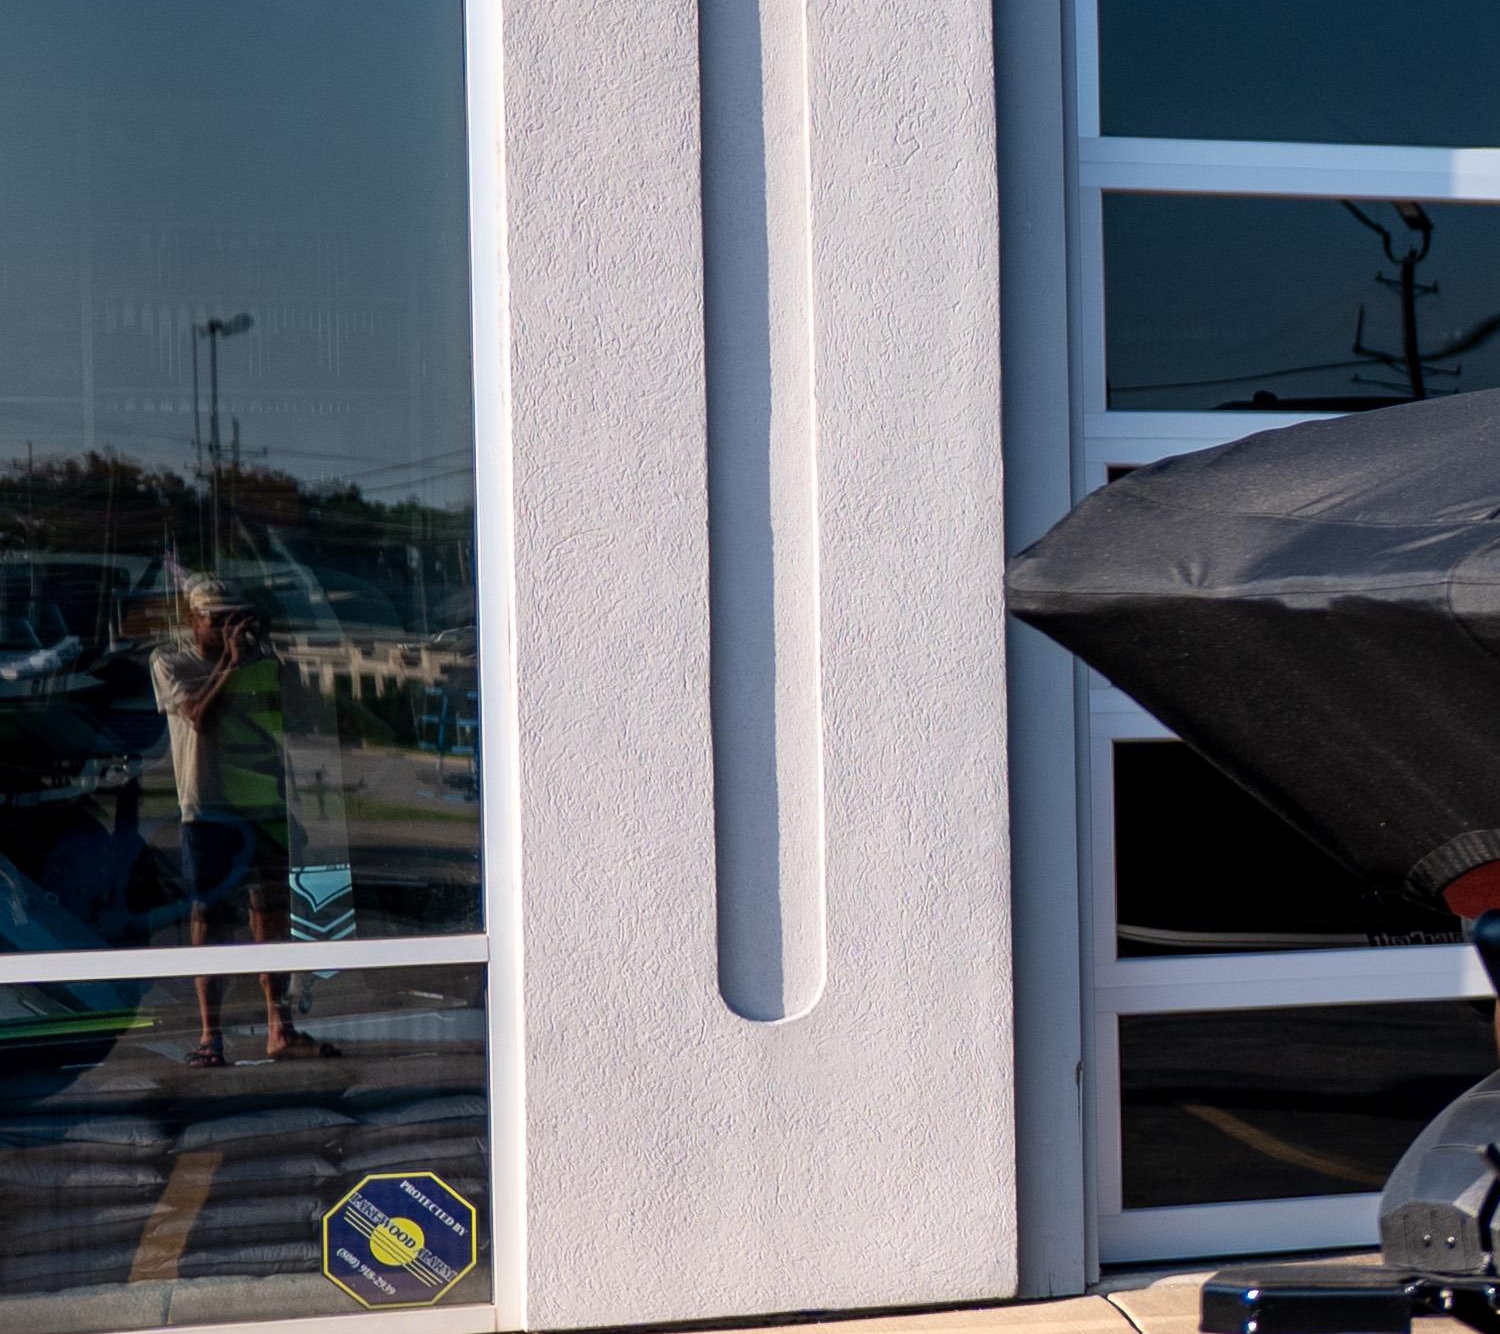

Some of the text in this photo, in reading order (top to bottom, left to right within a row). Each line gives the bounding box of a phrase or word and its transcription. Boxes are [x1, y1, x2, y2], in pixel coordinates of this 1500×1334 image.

[348, 1191, 417, 1249] LAKEWOOD
[400, 1180, 468, 1237] PROTECTED BY
